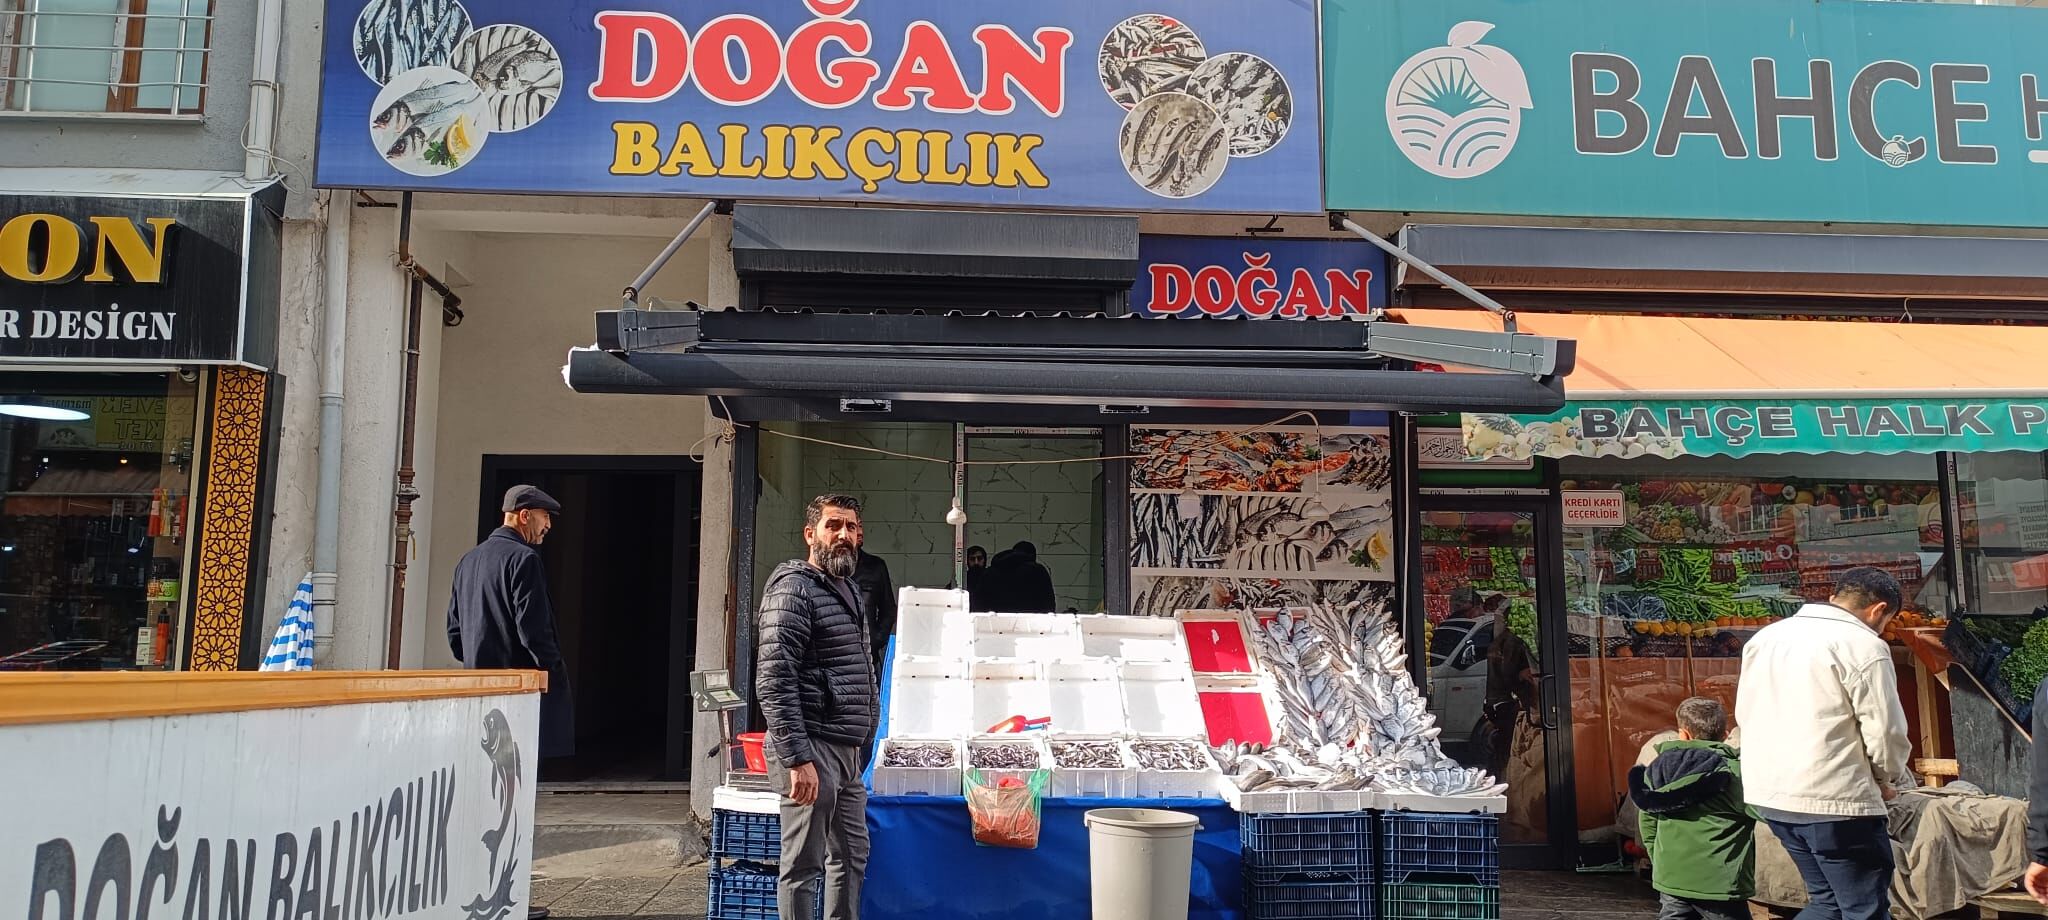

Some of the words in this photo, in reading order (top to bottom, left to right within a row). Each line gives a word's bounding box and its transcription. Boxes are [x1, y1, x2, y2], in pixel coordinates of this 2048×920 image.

[588, 0, 1074, 117] DOĞAN
[608, 120, 1050, 193] BALIKÇILIK
[1148, 251, 1373, 319] DOĞAN
[30, 302, 177, 340] DESİGN
[1578, 407, 1797, 446] BAHÇE
[1815, 405, 1994, 437] HALK
[1564, 497, 1592, 507] KREDİ
[1594, 498, 1620, 507] KARTI
[1567, 509, 1619, 520] GEÇERLİDİR
[27, 803, 258, 920] DOĞAN
